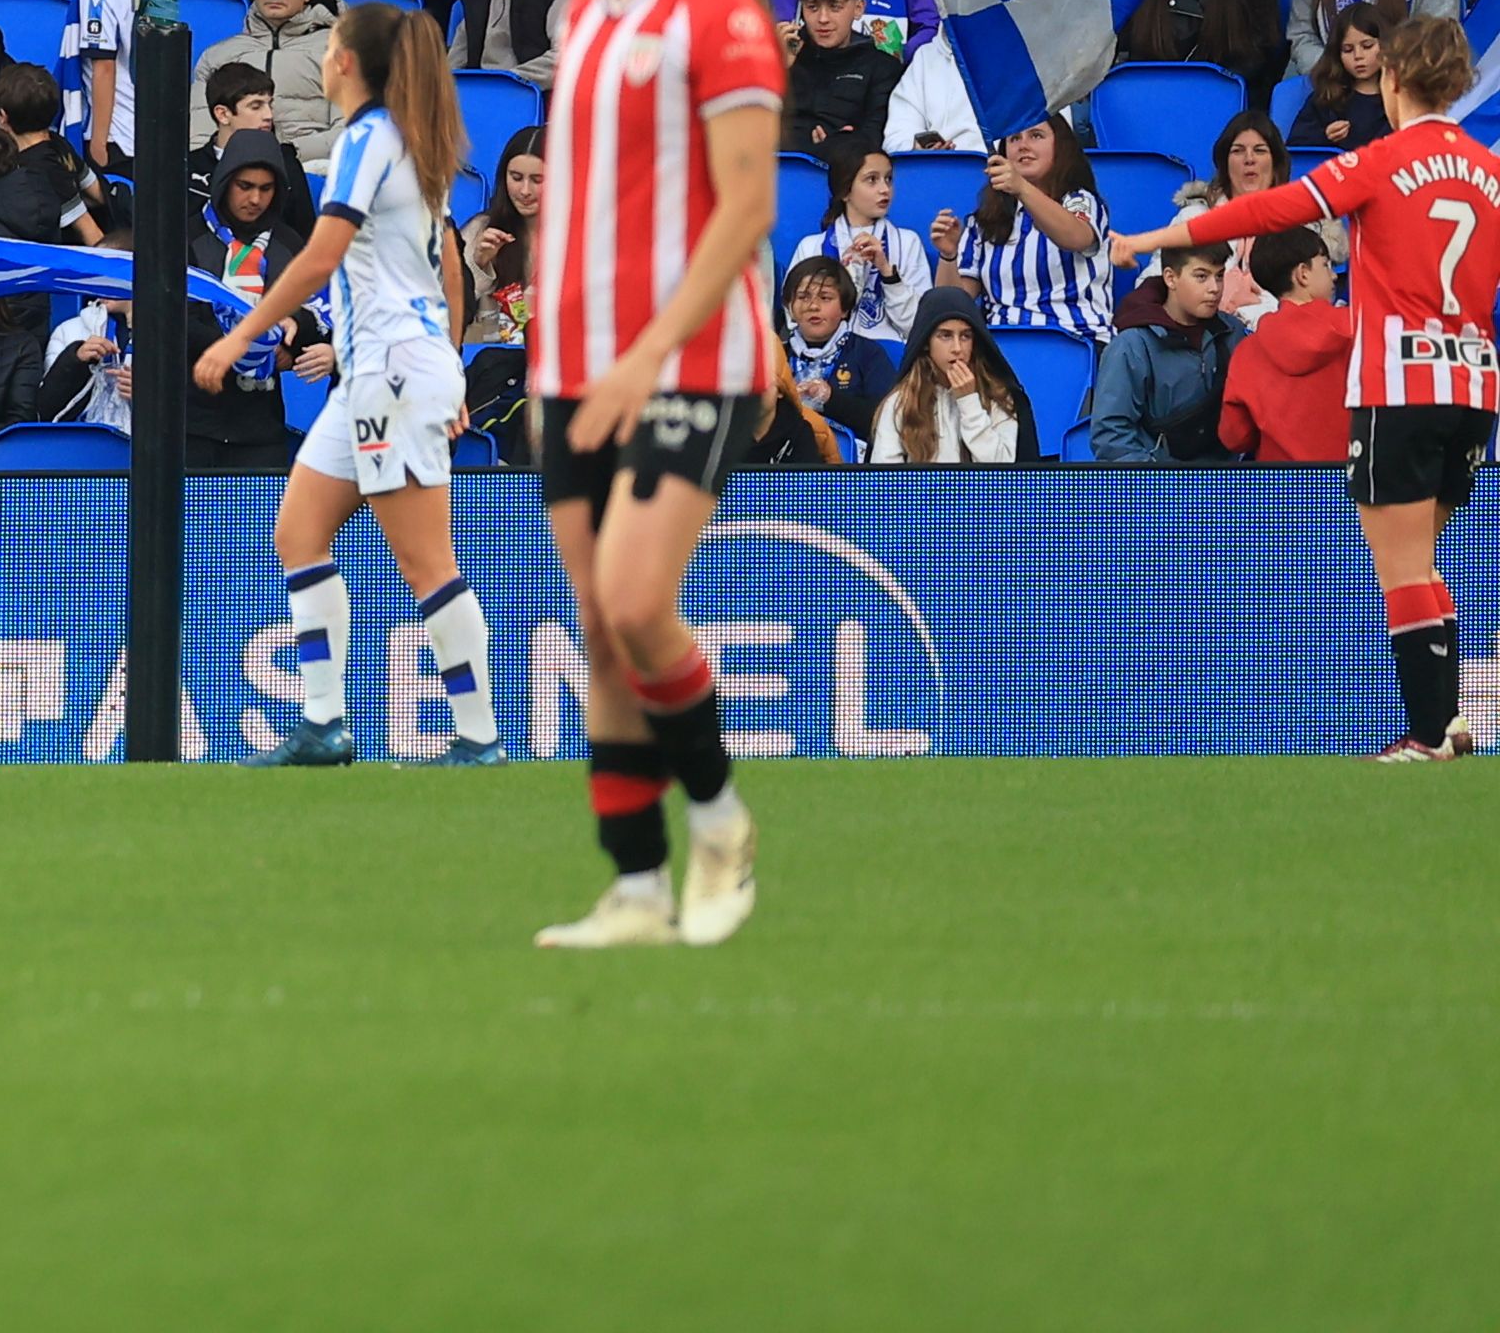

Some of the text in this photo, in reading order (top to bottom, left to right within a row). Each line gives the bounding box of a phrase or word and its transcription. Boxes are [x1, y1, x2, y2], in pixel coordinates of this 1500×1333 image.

[1391, 152, 1500, 210] NAHIKAR
[1429, 198, 1477, 316] 7
[355, 416, 389, 443] DV
